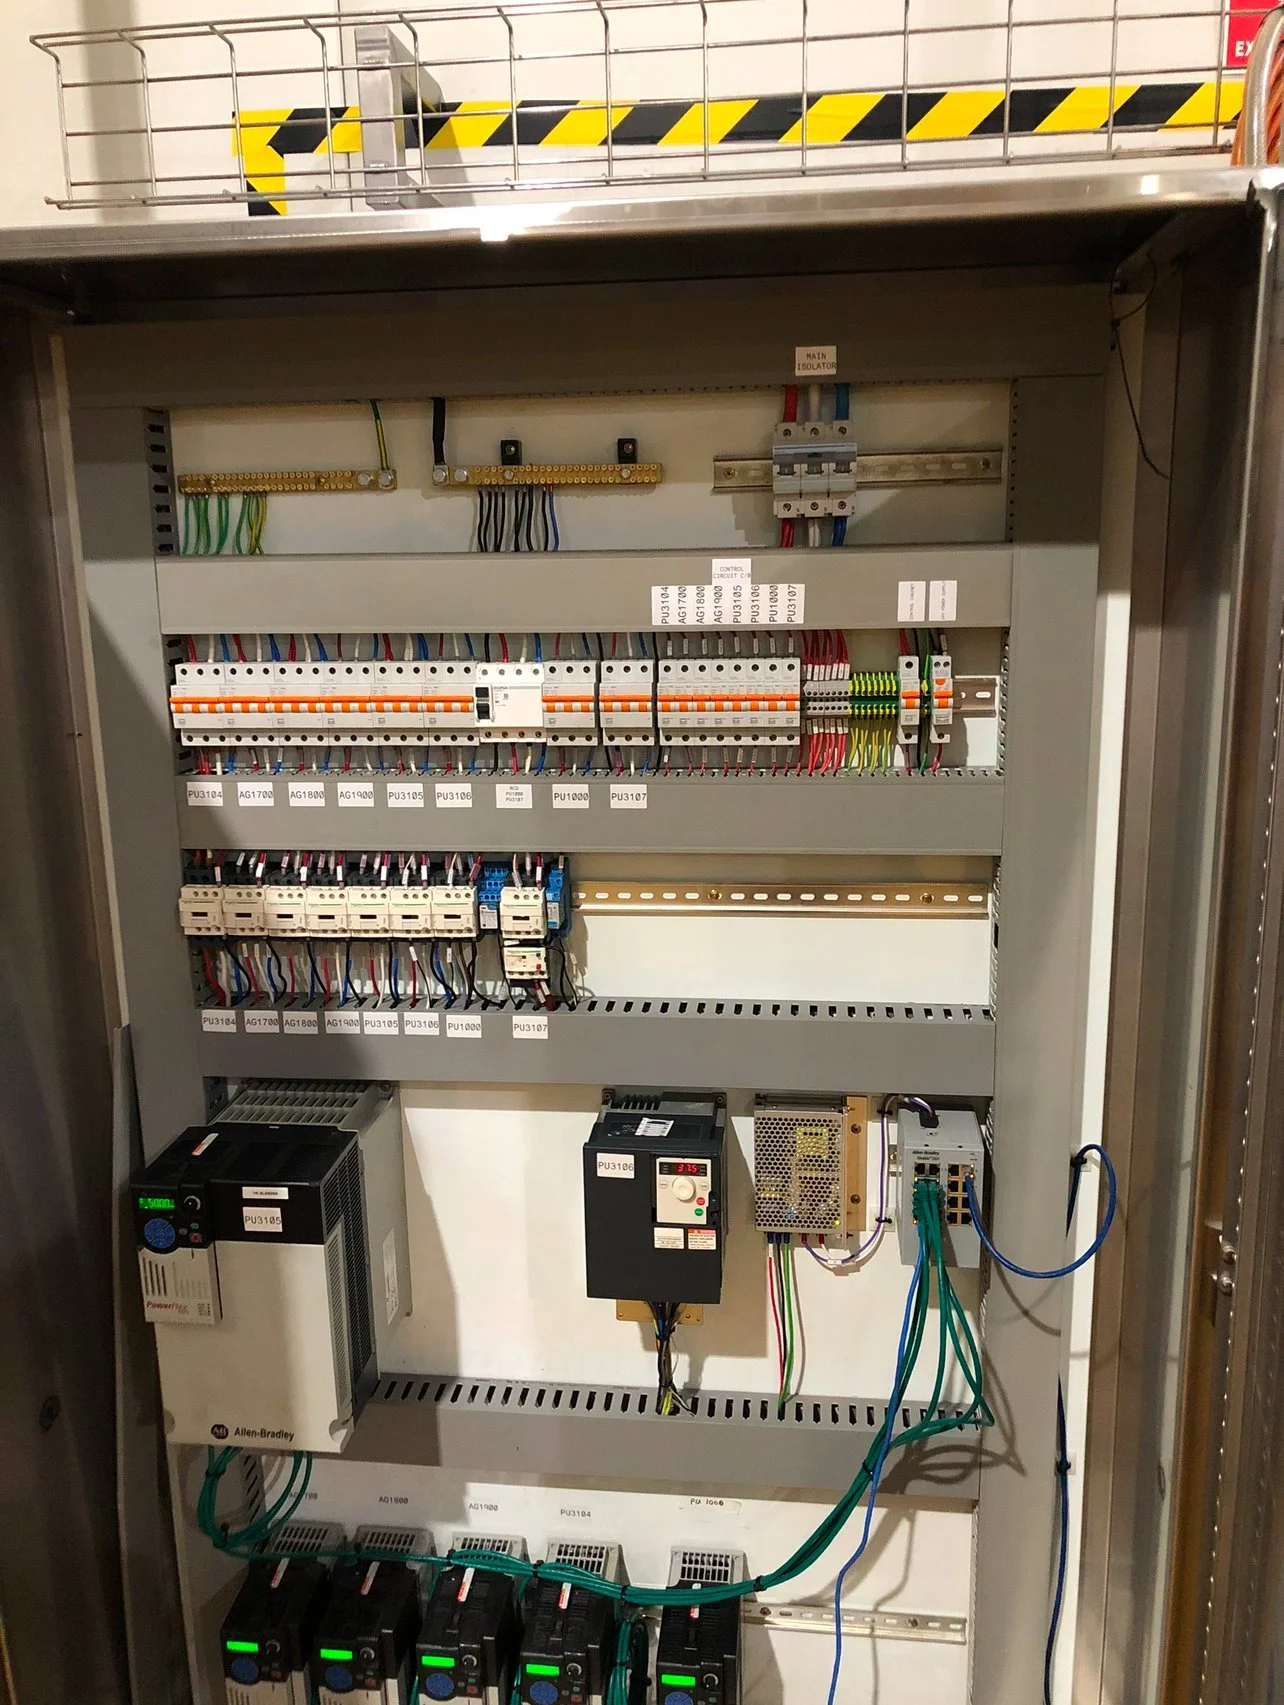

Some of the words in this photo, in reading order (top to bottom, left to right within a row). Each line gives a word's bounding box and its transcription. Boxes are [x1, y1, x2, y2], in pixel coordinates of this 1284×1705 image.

[806, 352, 827, 360] MAIN
[797, 362, 837, 371] ISOLATOR
[660, 586, 670, 624] PU3104
[677, 586, 687, 624] AG1700
[695, 586, 705, 624] AG1800
[713, 585, 723, 623] AG1900
[732, 585, 742, 623] PU3105
[750, 585, 760, 623] PU3106
[769, 585, 778, 622] PU1000
[787, 584, 797, 622] PU3107
[188, 790, 222, 799] PU3104
[239, 790, 274, 799] AG1700
[290, 791, 324, 799] AG1800
[339, 791, 374, 800] AG1900
[388, 791, 424, 800] PU3105
[436, 791, 472, 801] PU3106
[553, 792, 589, 801] PU1000
[611, 792, 647, 801] PU3107
[202, 1017, 236, 1026] PU3104
[245, 1017, 279, 1026] AG1700
[284, 1019, 318, 1028] AG1800
[326, 1018, 360, 1027] AG1900
[364, 1019, 399, 1028] PU3105
[405, 1020, 439, 1029] PU3106
[448, 1022, 481, 1031] PU1000
[513, 1023, 548, 1032] PU3107
[598, 1161, 634, 1172] PU3106
[245, 1216, 282, 1225] PU3105
[234, 1427, 294, 1442] Allen-Bradley
[379, 1496, 408, 1504] AG1800
[468, 1503, 498, 1511] AG1900
[560, 1509, 591, 1518] PU3104
